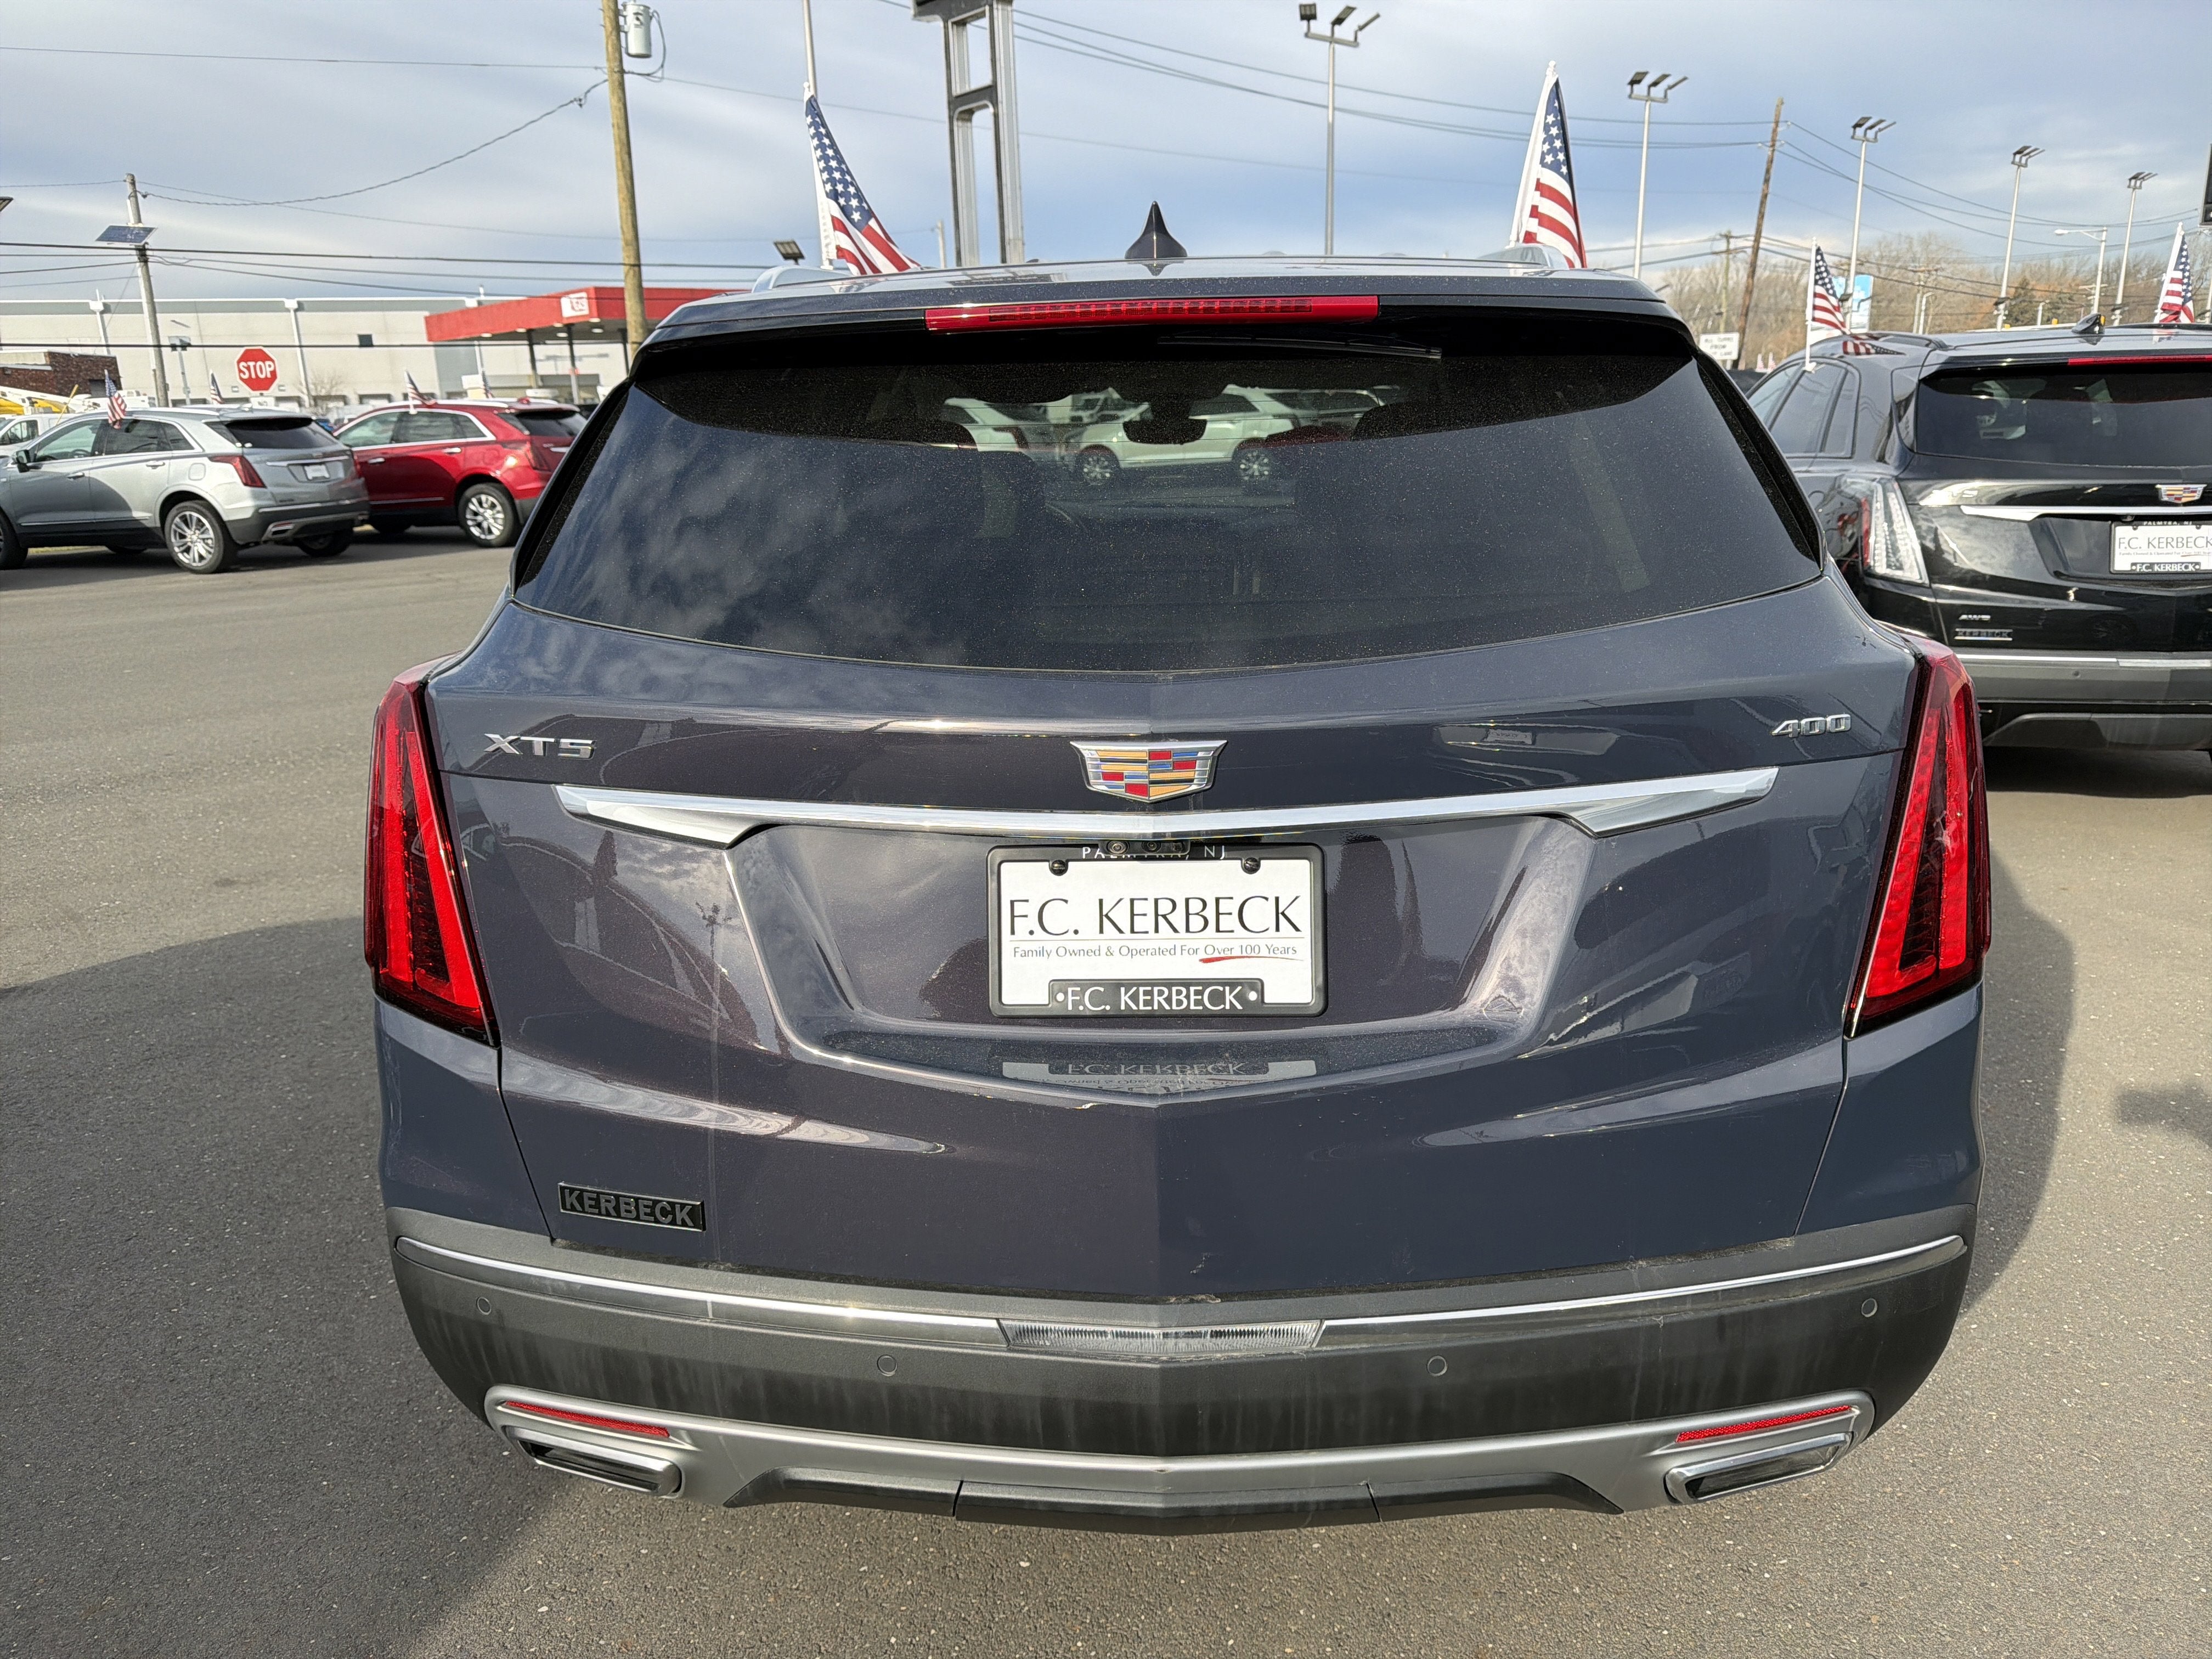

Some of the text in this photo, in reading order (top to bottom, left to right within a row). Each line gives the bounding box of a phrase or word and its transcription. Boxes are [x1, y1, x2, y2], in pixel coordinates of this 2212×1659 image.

[239, 361, 274, 379] STOP
[2119, 536, 2212, 550] F.C. KERBECK
[2136, 563, 2196, 572] F.C. KERBECK
[1770, 714, 1852, 738] 400
[484, 733, 596, 759] XT5
[1204, 845, 1225, 860] NJ
[1009, 895, 1302, 936] F.C. KERBECK
[1013, 944, 1297, 960] Family Owned & Operated For Over 100 Years
[1067, 985, 1243, 1011] F.C. KERBECK
[564, 1188, 695, 1227] KERBECK
